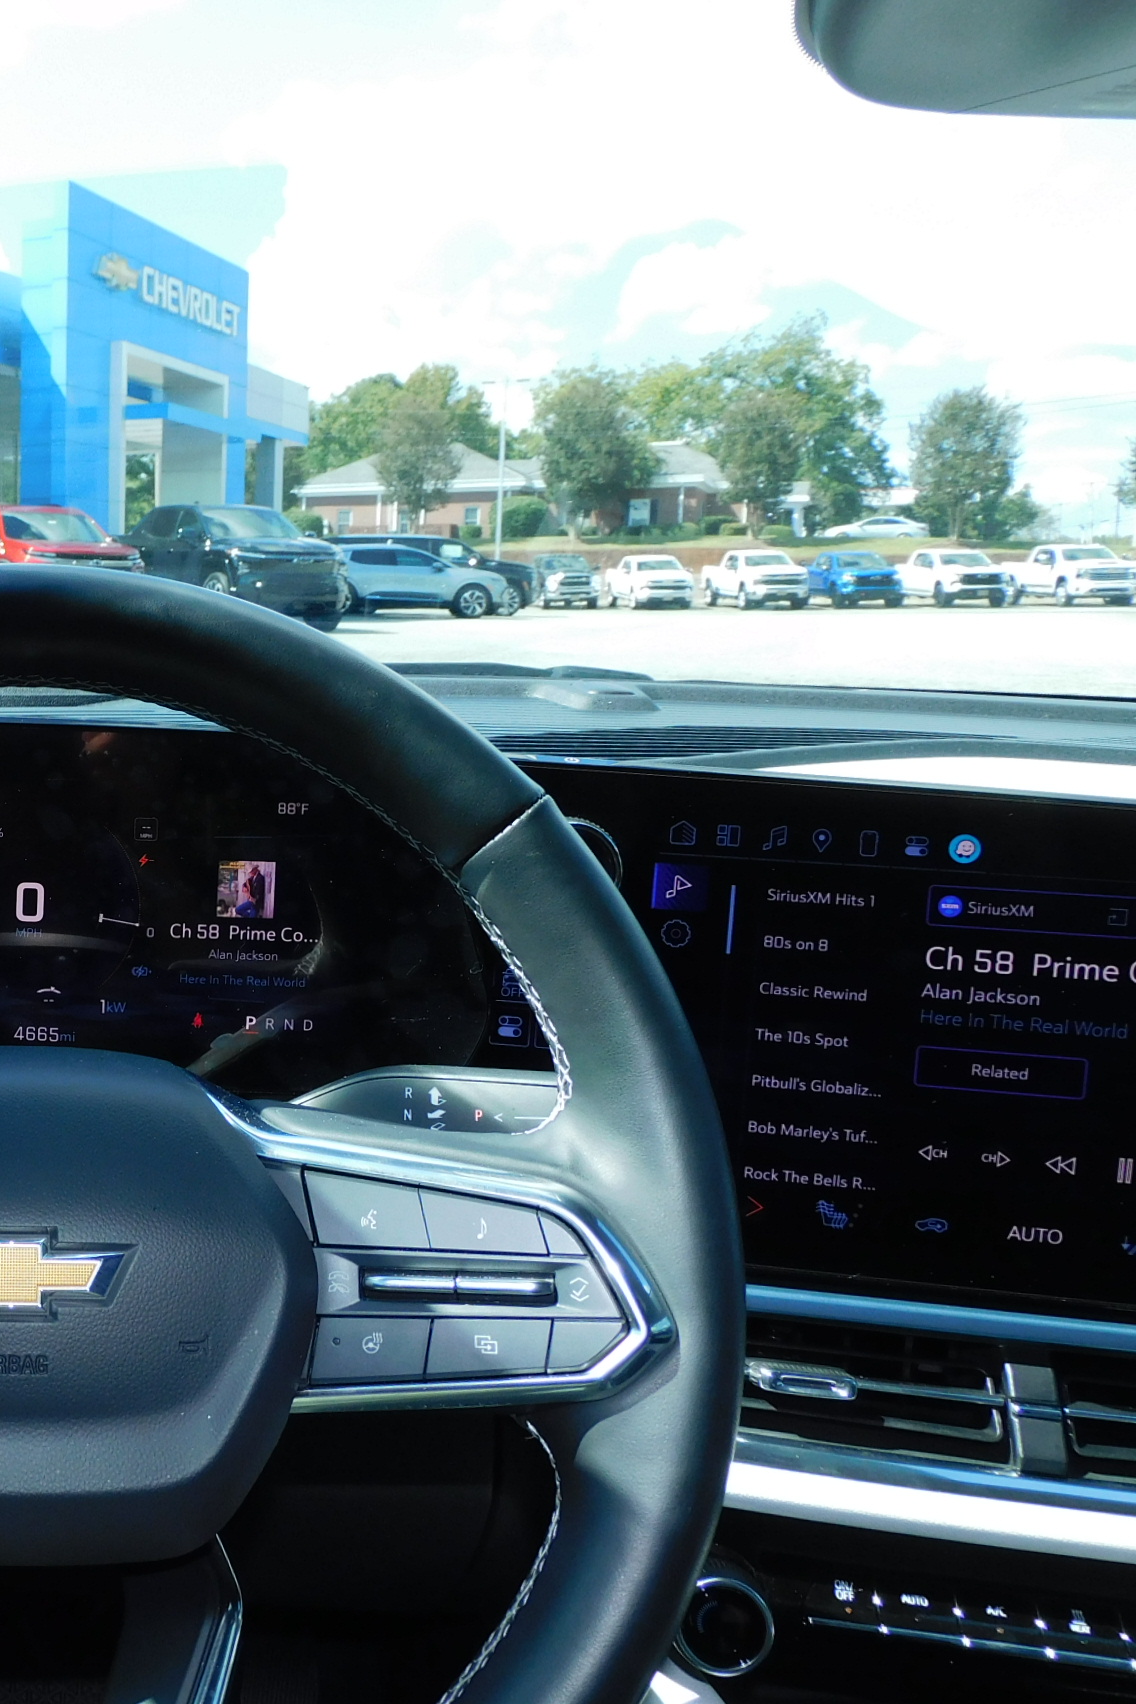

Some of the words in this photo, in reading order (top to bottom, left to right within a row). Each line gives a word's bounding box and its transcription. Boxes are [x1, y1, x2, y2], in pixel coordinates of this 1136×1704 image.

[142, 265, 241, 337] CHEVROLET
[278, 802, 309, 815] 88°F
[16, 882, 45, 922] 0
[767, 888, 831, 905] SiriusXM
[835, 893, 865, 907] Hits
[869, 895, 875, 907] 1
[967, 901, 1034, 918] SiriusXM
[15, 927, 43, 938] MPH
[146, 927, 155, 938] 0
[170, 923, 191, 939] Ch
[197, 924, 219, 940] 58
[229, 925, 276, 942] Prime
[281, 927, 319, 943] Co...
[764, 935, 792, 950] 80s
[796, 940, 814, 950] on
[818, 939, 828, 951] 8
[208, 949, 232, 961] Alan
[235, 950, 278, 962] Jackson
[925, 946, 963, 971] Ch
[973, 949, 1014, 975] 58
[1032, 953, 1119, 982] Prime
[179, 973, 205, 985] Here
[209, 974, 219, 985] In
[223, 975, 242, 986] The
[246, 975, 270, 987] Real
[273, 976, 306, 988] World
[759, 982, 810, 998] Classic
[814, 986, 867, 1002] Rewind
[921, 983, 962, 1000] Alan
[967, 986, 1040, 1006] Jackson
[245, 1016, 257, 1030] P
[265, 1018, 274, 1030] R
[284, 1019, 294, 1030] N
[303, 1019, 313, 1031] D
[921, 1009, 962, 1026] Here
[969, 1013, 984, 1028] In
[990, 1013, 1024, 1031] The
[1030, 1017, 1068, 1035] Real
[1074, 1020, 1128, 1039] World
[755, 1028, 782, 1042] The
[787, 1030, 811, 1045] 10s
[815, 1033, 849, 1049] Spot
[971, 1064, 1029, 1080] Related
[404, 1087, 413, 1099] R
[751, 1074, 807, 1091] Pitbull's
[810, 1079, 882, 1098] Globaliz...
[403, 1109, 412, 1121] N
[475, 1110, 483, 1121] P
[748, 1120, 776, 1136] Bob
[780, 1123, 839, 1144] Marley's
[844, 1129, 878, 1145] Tuf...
[932, 1148, 948, 1159] CH
[981, 1153, 996, 1163] CH
[744, 1166, 778, 1182] Rock
[783, 1170, 809, 1186] The
[813, 1173, 847, 1189] Bells
[1007, 1225, 1063, 1245] AUTO
[835, 1589, 854, 1601] OFF
[900, 1593, 929, 1606] AUTO
